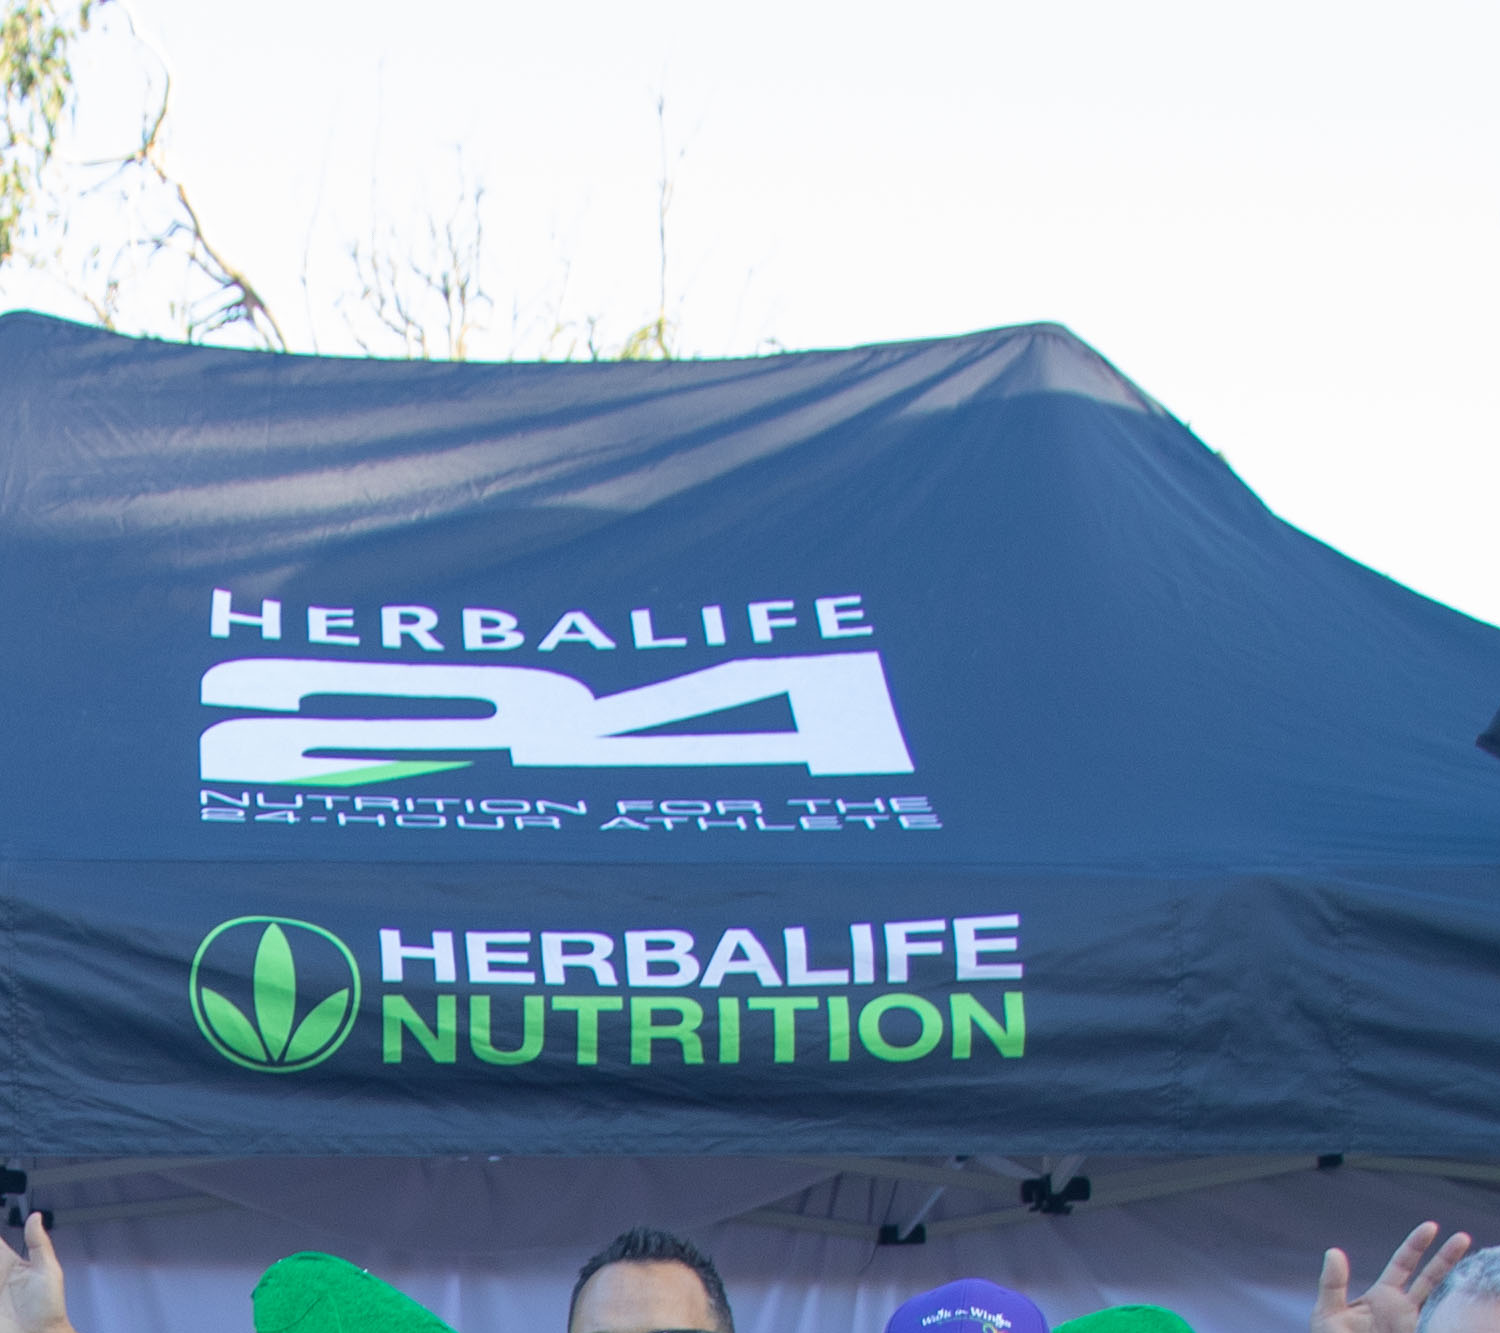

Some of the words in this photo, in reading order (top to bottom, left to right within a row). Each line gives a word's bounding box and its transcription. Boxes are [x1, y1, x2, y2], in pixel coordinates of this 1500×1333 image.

[211, 588, 874, 651] HERBALIFE
[200, 652, 915, 786] 24
[200, 789, 587, 815] NUTRITION
[616, 797, 764, 814] FOR
[787, 796, 935, 814] THE
[200, 808, 562, 829] 24-HOUR
[600, 814, 943, 830] ATHLETE
[380, 914, 1024, 987] HERBALIFE
[382, 991, 1026, 1065] NUTRITION
